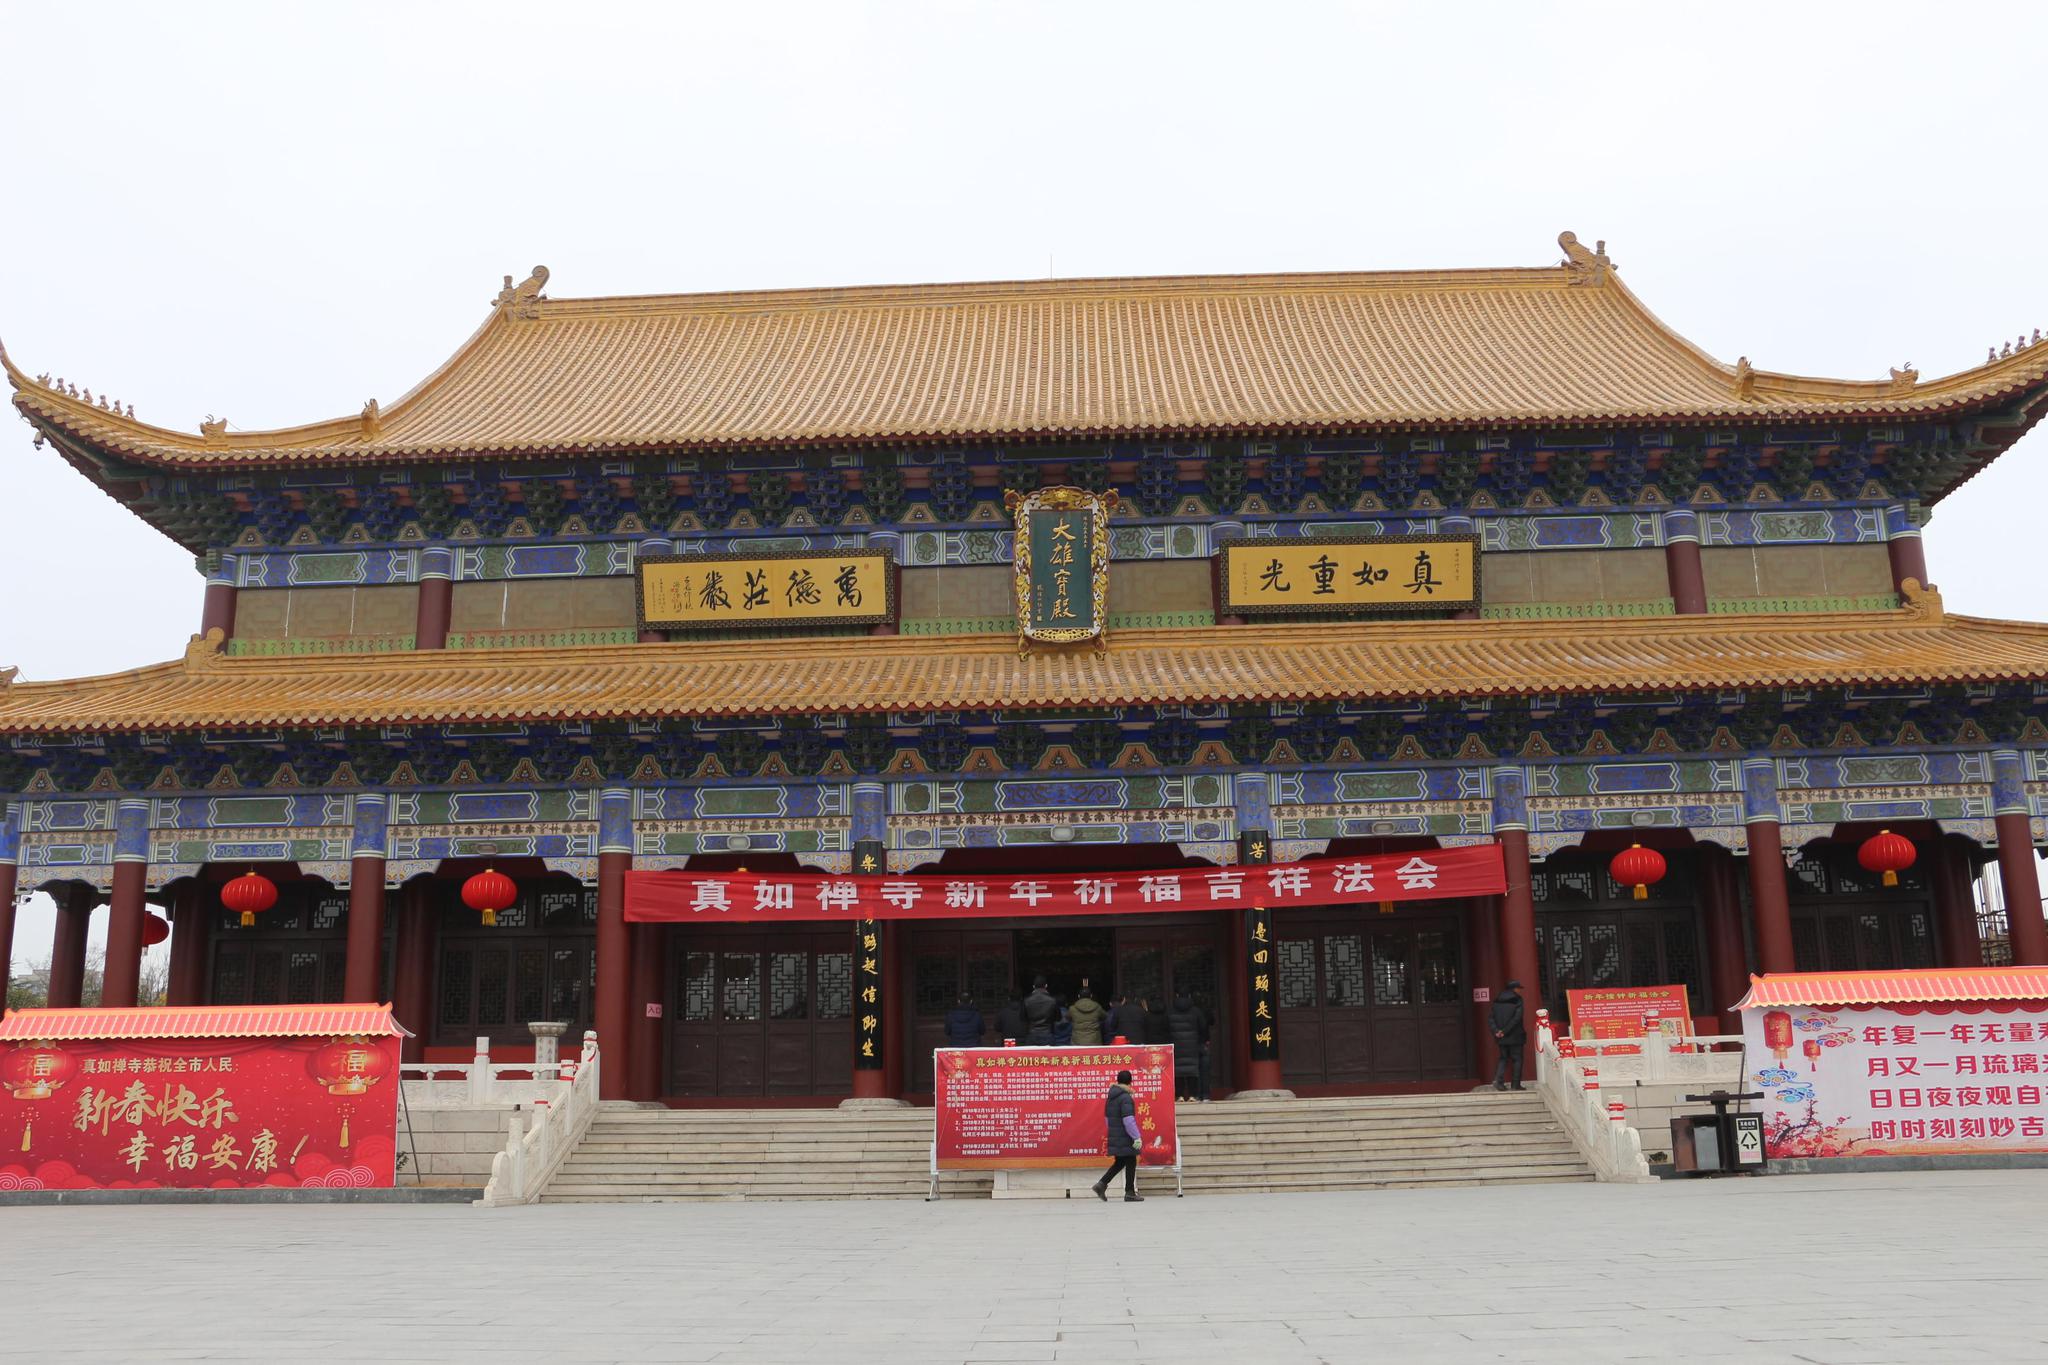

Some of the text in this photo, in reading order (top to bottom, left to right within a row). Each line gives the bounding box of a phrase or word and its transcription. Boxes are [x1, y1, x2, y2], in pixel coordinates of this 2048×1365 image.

[1050, 518, 1077, 621] 大雄寶殿
[1259, 550, 1443, 595] 真如重光
[690, 857, 1438, 912] 真如禅寺新年祈福吉祥法会
[17, 1054, 54, 1076] 福
[331, 1050, 368, 1072] 福
[976, 1054, 1133, 1068] 真如禅寺2018年新春祈福系列法会
[1867, 1053, 2048, 1077] 月又一月琉璃
[74, 1080, 239, 1136] 新春快乐
[1870, 1085, 2048, 1109] 日日夜夜观自
[1871, 1116, 2045, 1140] 时时刻刻妙吉
